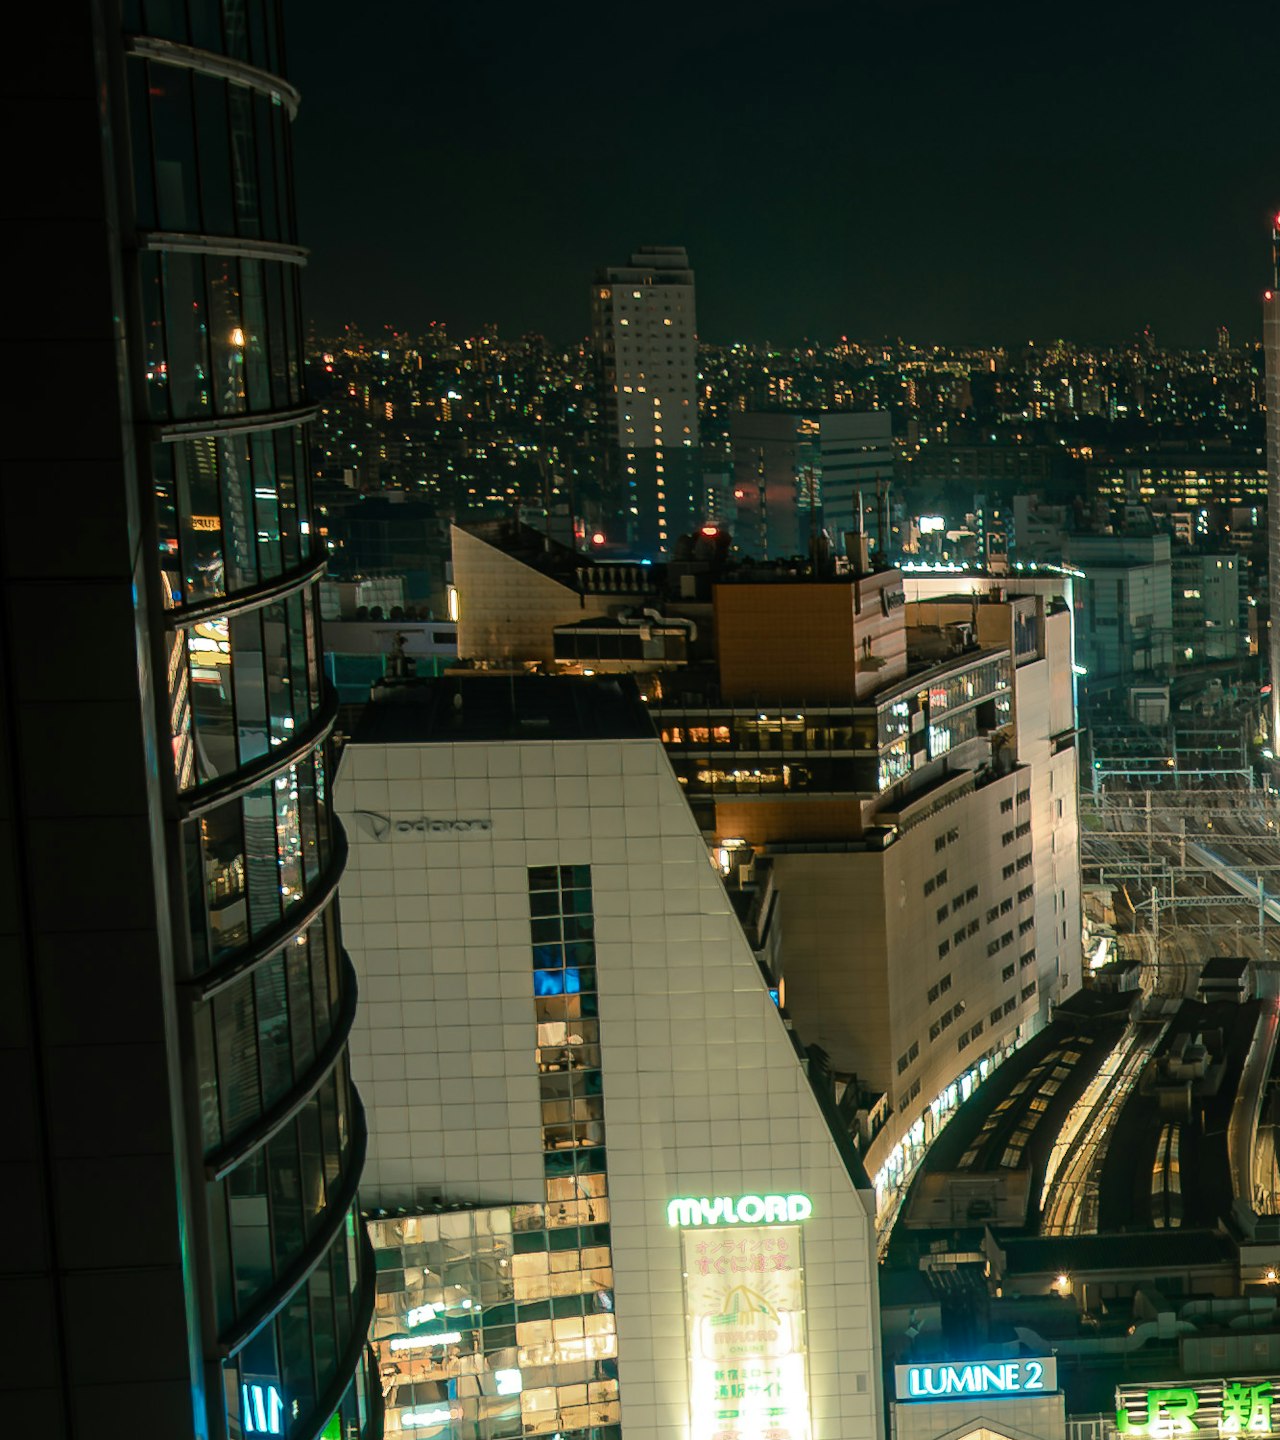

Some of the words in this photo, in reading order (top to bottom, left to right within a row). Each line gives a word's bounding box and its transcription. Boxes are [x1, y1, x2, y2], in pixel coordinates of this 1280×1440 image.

[667, 1194, 812, 1227] MYLORD
[908, 1363, 1021, 1396] LUMINE
[1024, 1361, 1044, 1390] 2
